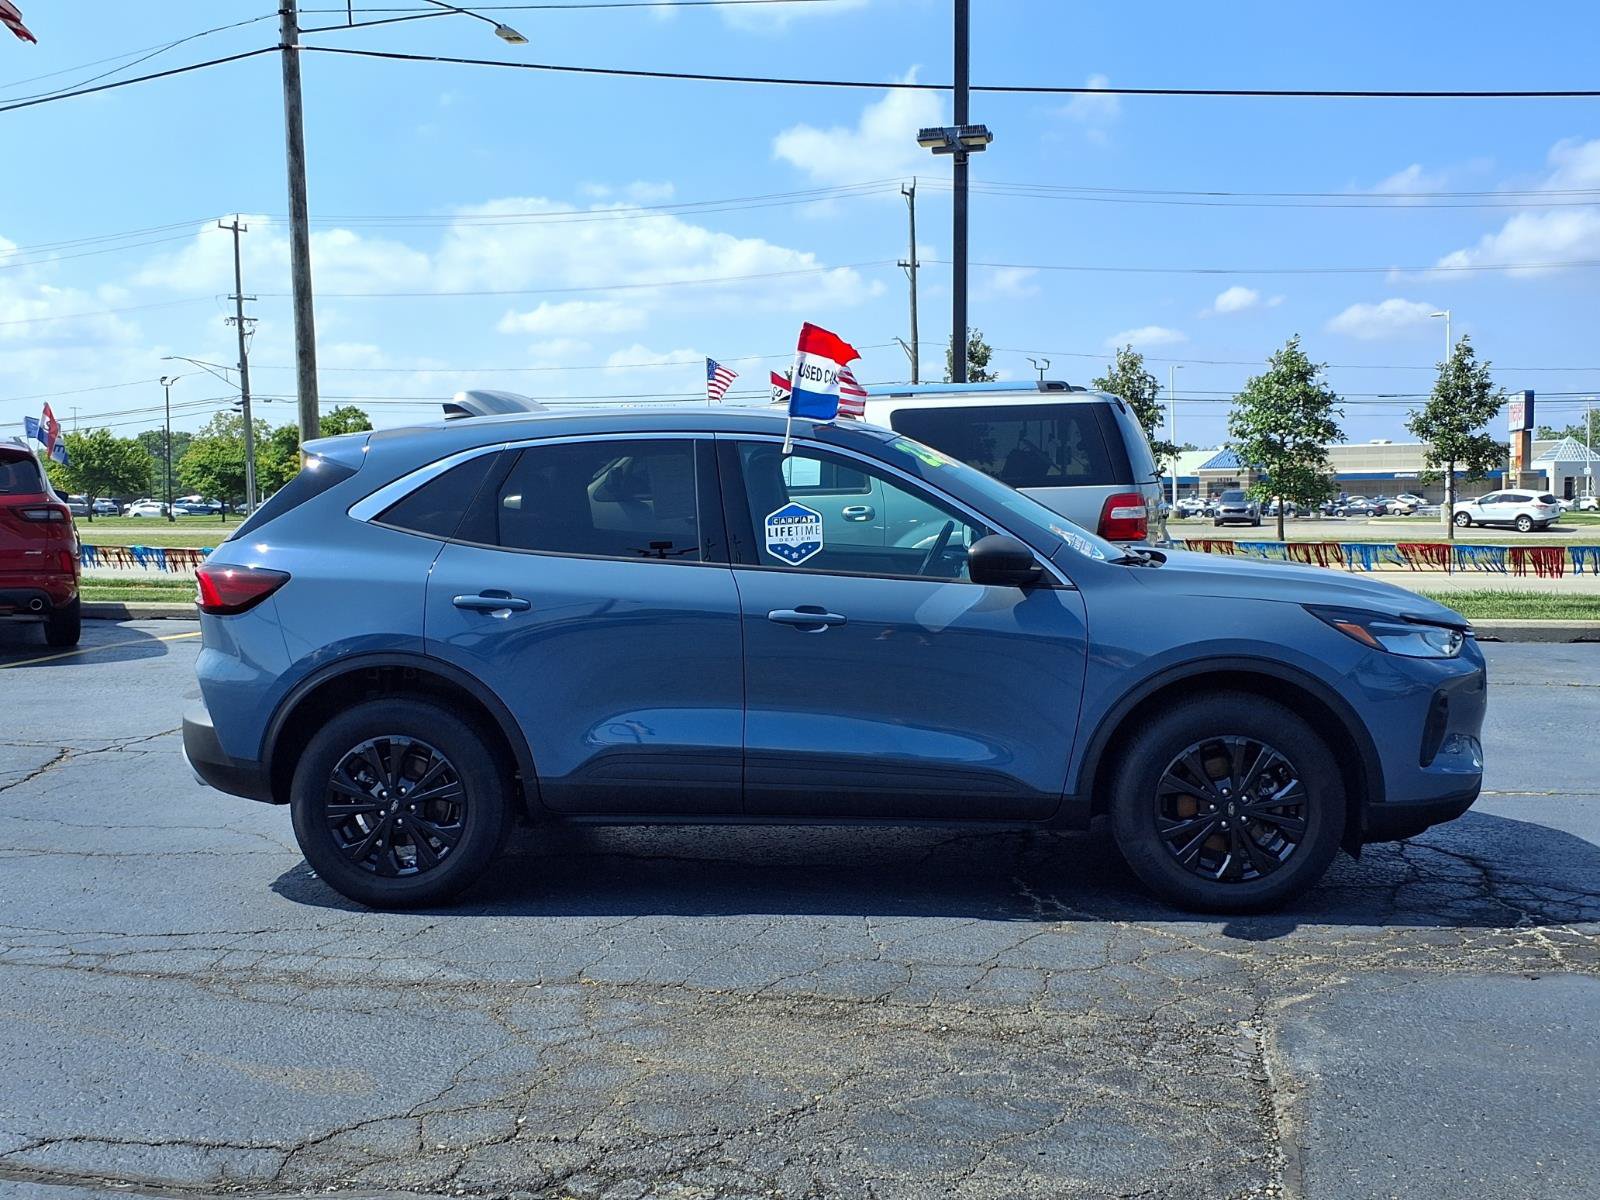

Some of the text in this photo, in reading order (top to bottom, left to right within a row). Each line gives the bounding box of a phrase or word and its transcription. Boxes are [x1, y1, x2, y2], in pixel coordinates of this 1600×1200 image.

[798, 362, 822, 382] USED
[773, 515, 816, 525] CARFAX
[768, 525, 820, 537] LIFETIME
